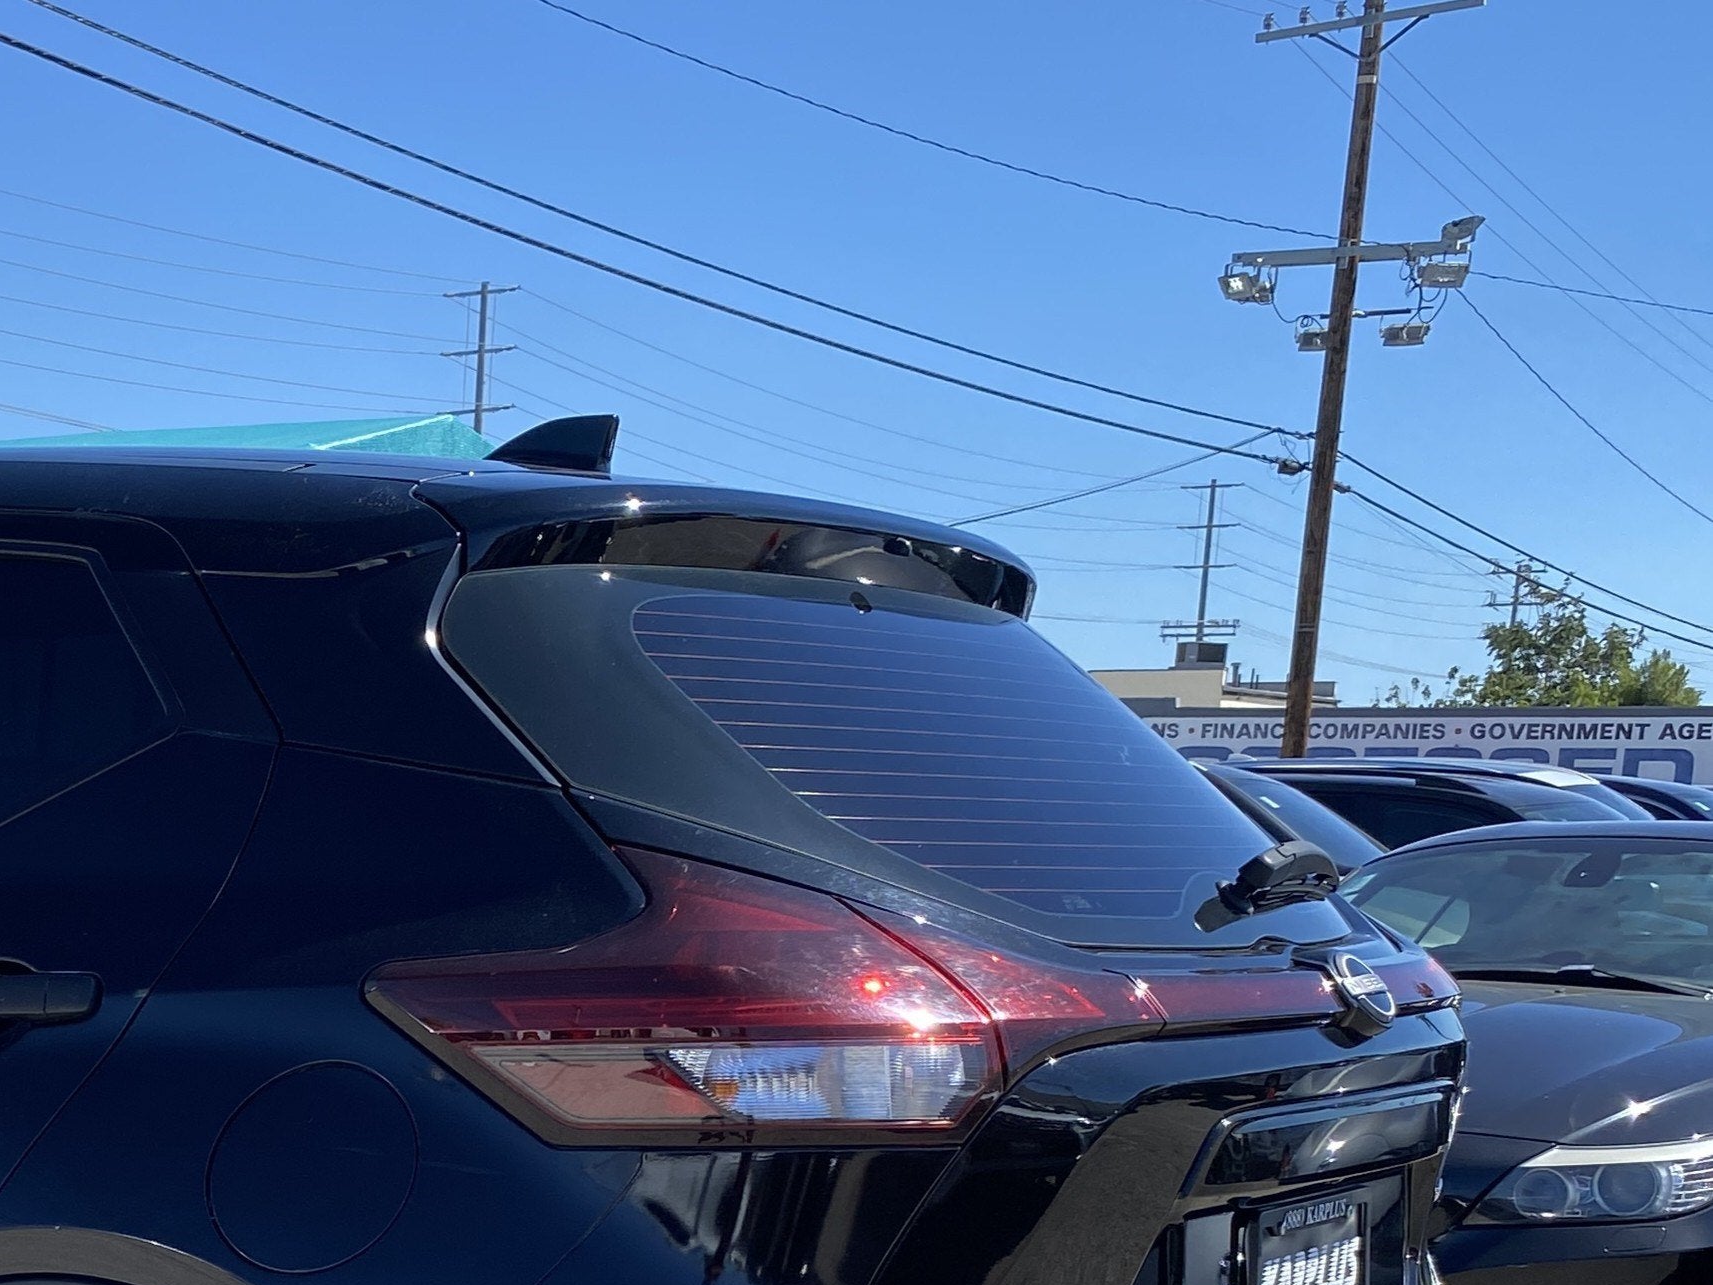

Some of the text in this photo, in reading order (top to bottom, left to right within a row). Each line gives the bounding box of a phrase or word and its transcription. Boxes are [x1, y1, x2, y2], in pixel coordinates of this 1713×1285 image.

[1200, 723, 1285, 739] FINANC
[1307, 723, 1446, 740] COMPANIES
[1469, 722, 1651, 740] GOVERNMENT
